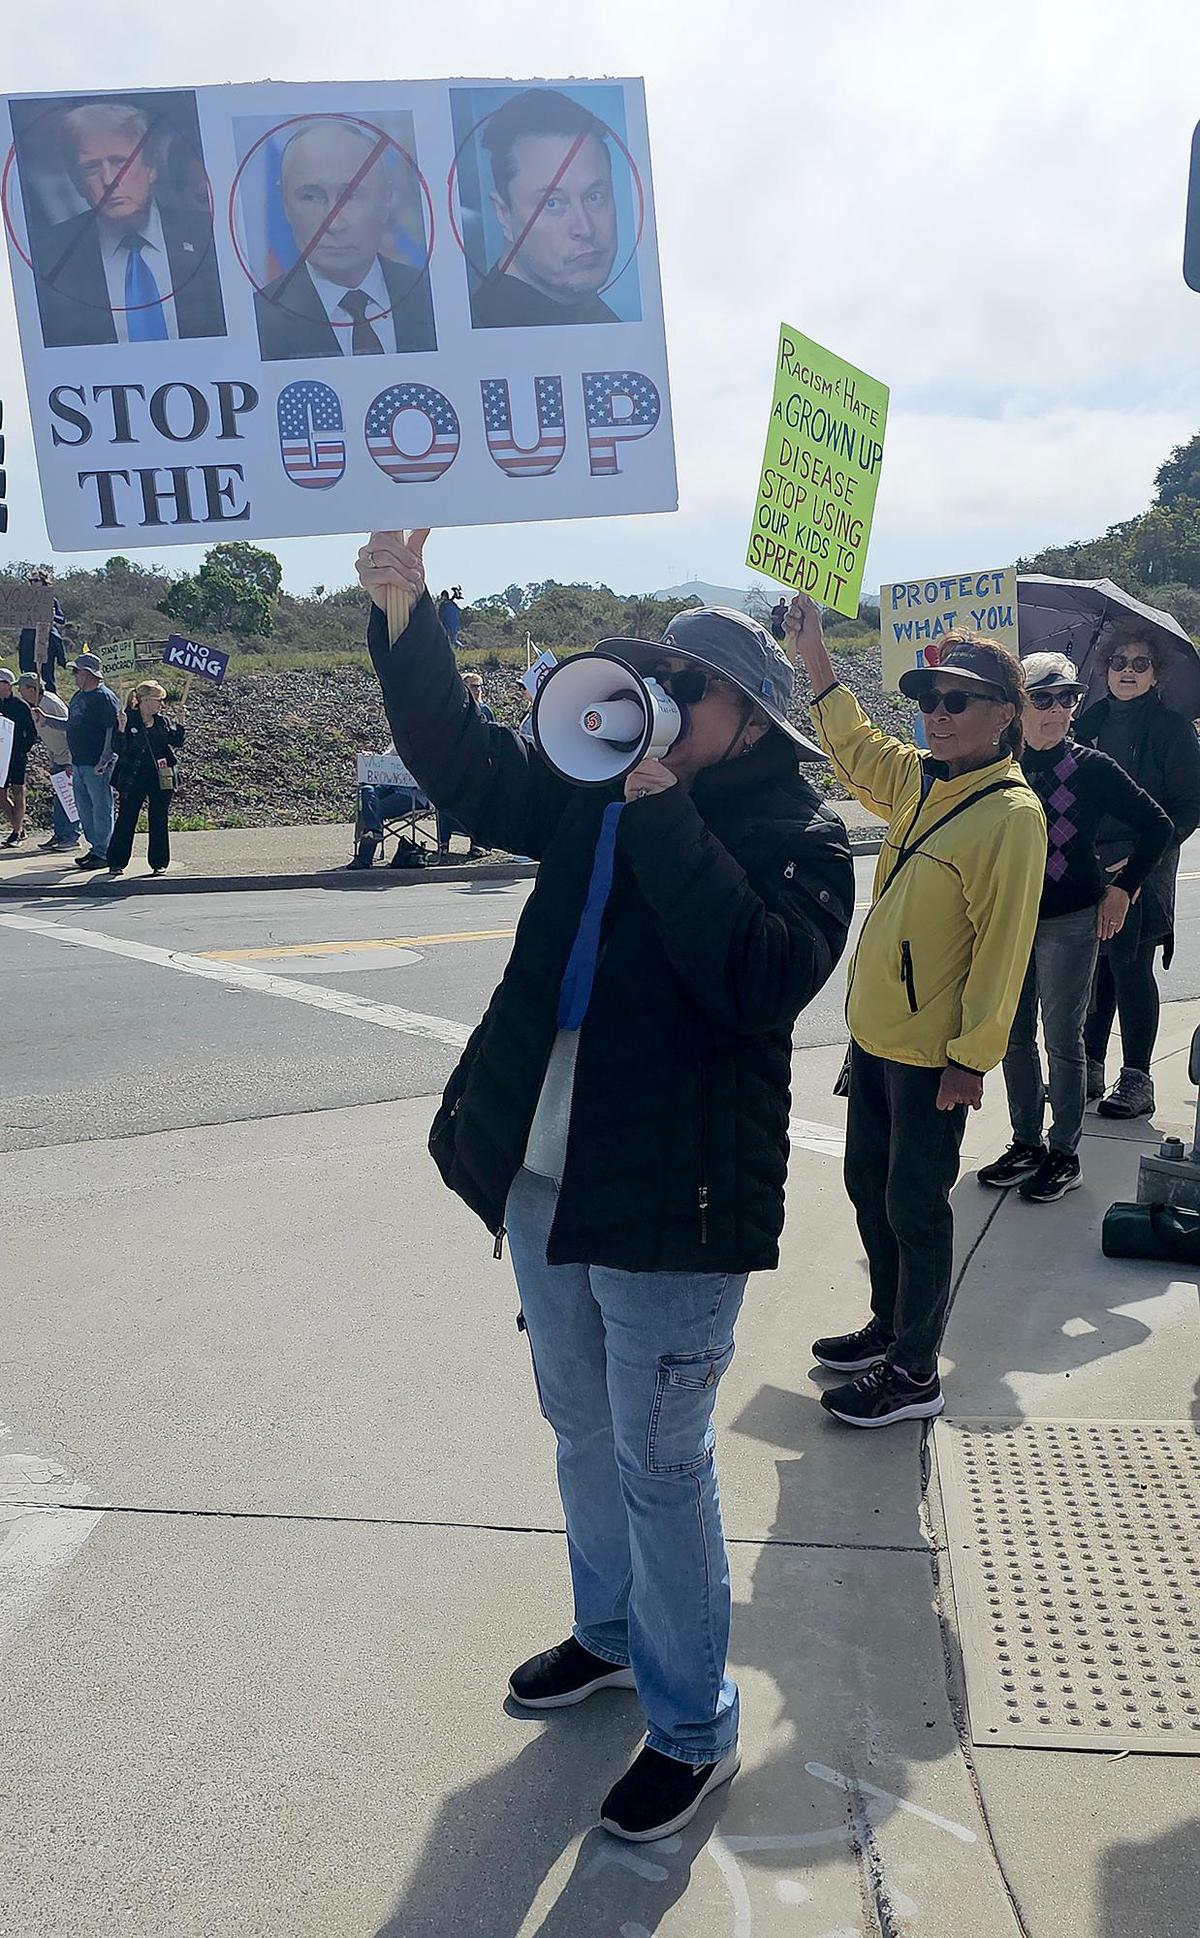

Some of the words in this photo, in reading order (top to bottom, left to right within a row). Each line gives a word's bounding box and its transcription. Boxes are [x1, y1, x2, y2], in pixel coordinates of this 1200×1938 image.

[48, 380, 259, 448] STOP
[780, 338, 833, 399] RACISM
[843, 377, 879, 428] HATE
[774, 401, 782, 420] A
[786, 393, 856, 462] GROWN
[859, 434, 882, 475] UP
[78, 463, 252, 529] THE
[780, 438, 858, 506] DISEASE
[758, 504, 788, 538] OUR
[795, 524, 830, 560] KIDS
[836, 544, 854, 573] TO
[762, 469, 806, 514] STOP
[812, 494, 863, 548] USING
[750, 533, 818, 592] SPREAD
[824, 570, 847, 607] IT
[891, 572, 1005, 610] PROTECT
[101, 644, 119, 656] STAND
[186, 642, 210, 658] NO
[893, 611, 957, 644] WHAT
[971, 606, 1013, 631] YOU
[102, 660, 134, 674] DEMOCRACY
[169, 648, 221, 677] KING
